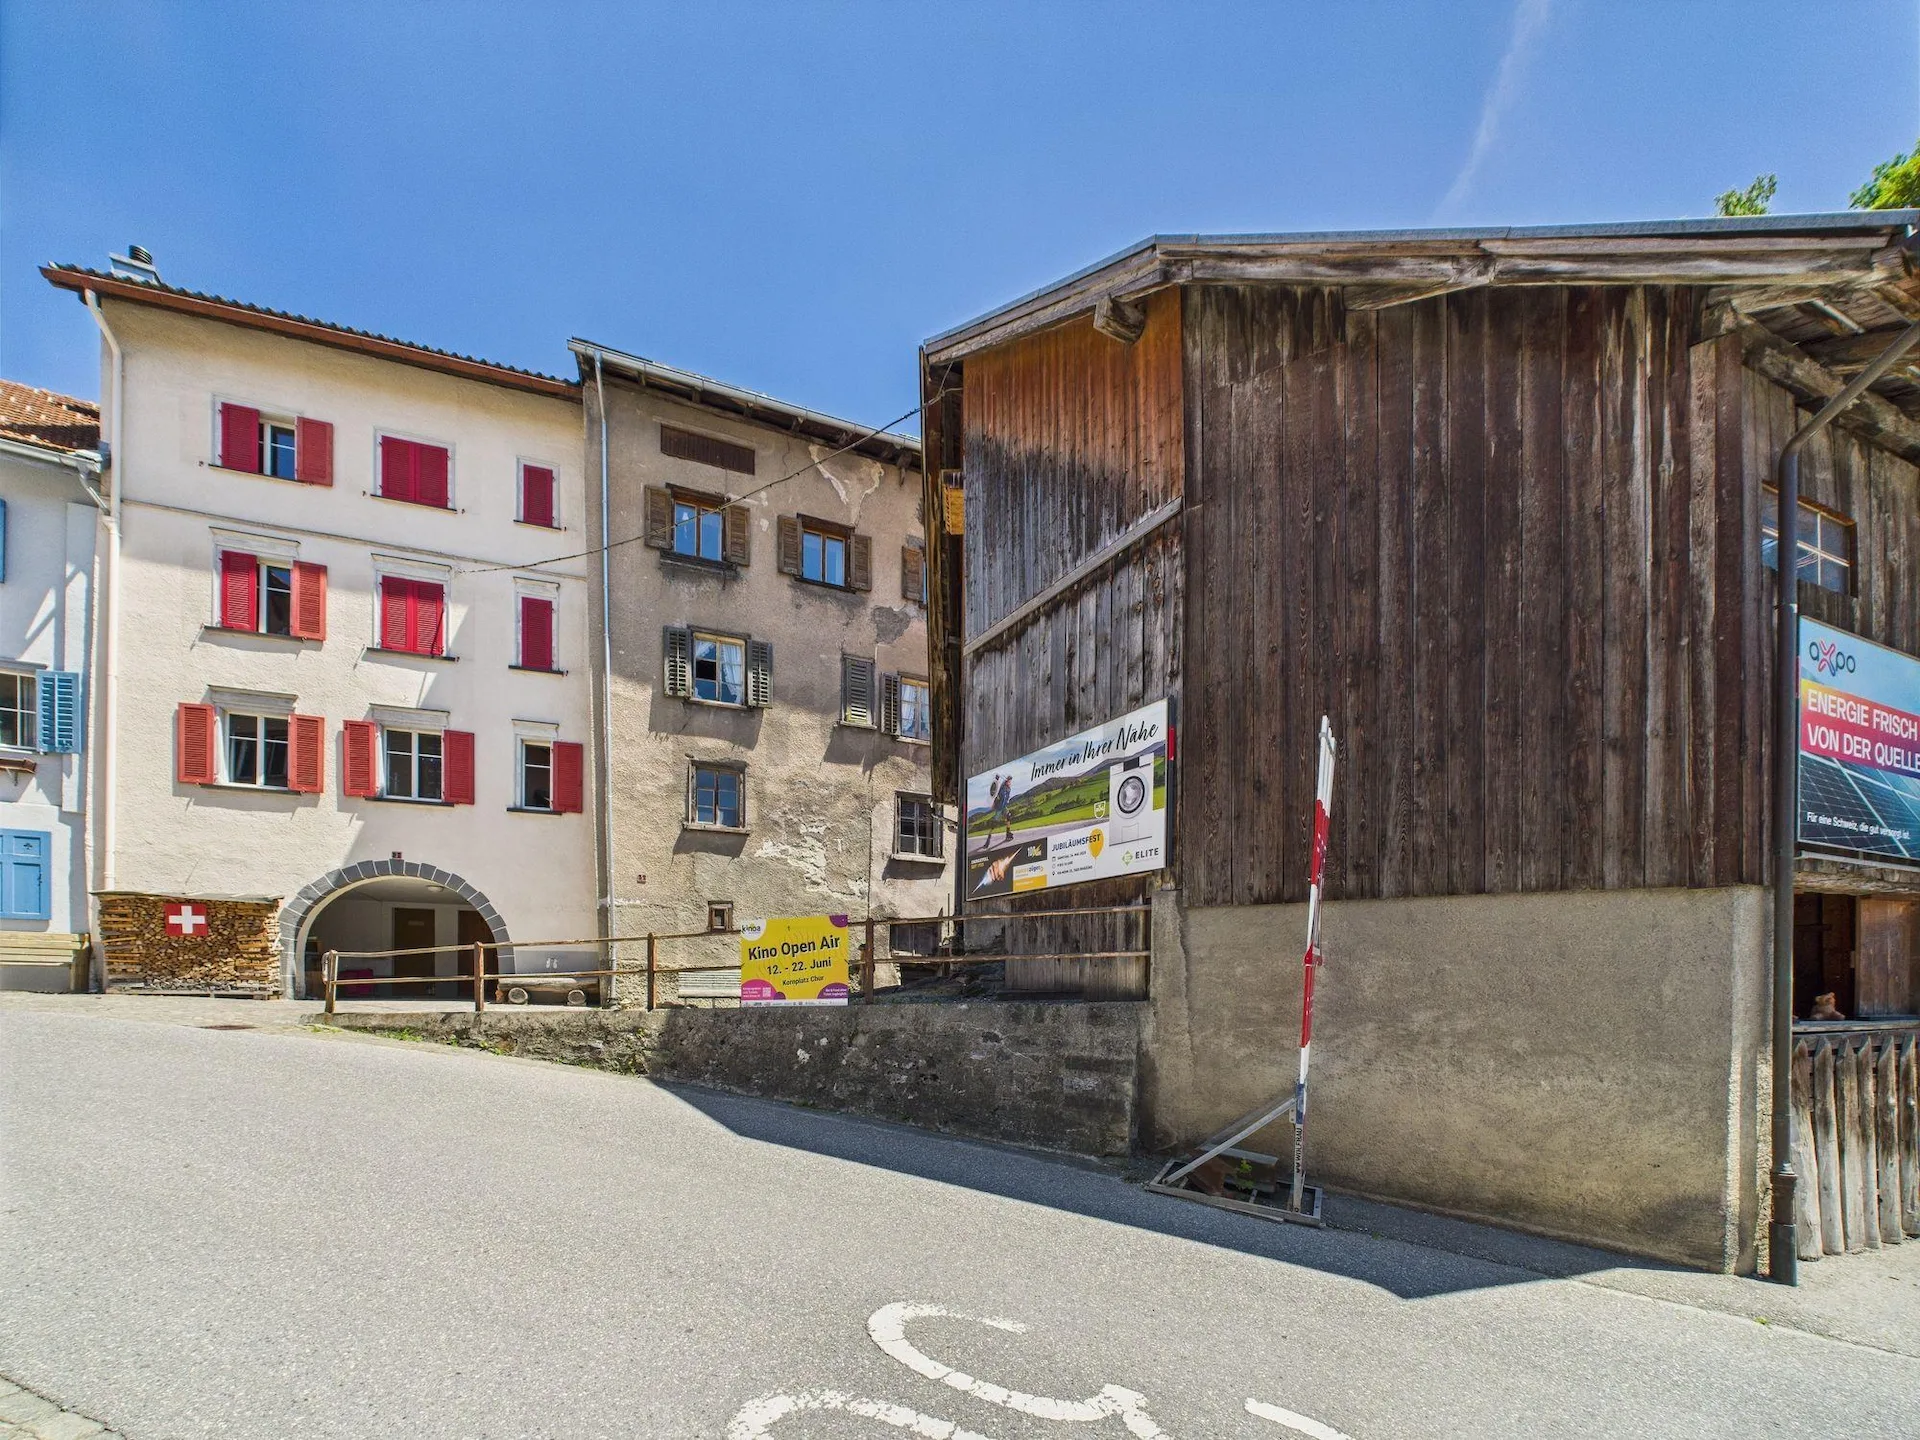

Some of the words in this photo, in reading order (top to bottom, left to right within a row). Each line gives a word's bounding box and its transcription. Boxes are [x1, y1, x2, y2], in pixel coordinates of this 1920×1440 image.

[1807, 689, 1870, 727] ENERGIE
[1872, 708, 1918, 741] FRISCH
[1031, 757, 1066, 781] Immer
[1068, 753, 1083, 765] in
[1083, 739, 1115, 763] Ihrer
[1116, 721, 1159, 750] Nähe
[1807, 723, 1840, 752] VON
[1843, 733, 1871, 760] DER
[1806, 812, 1818, 823] Für
[1818, 815, 1832, 825] eine
[1833, 816, 1858, 832] Schweiz,
[1860, 822, 1869, 832] die
[1869, 824, 1879, 835] gut
[1052, 833, 1101, 851] JUBILÄUMSFEST
[1135, 847, 1159, 859] ELITE
[748, 946, 778, 960] Kino
[781, 940, 816, 957] Open
[820, 935, 840, 950] Air
[767, 965, 782, 975] 12.
[792, 961, 807, 972] 22.
[810, 956, 832, 969] Juni
[782, 977, 809, 986] Kornplatz
[810, 975, 825, 983] Chur
